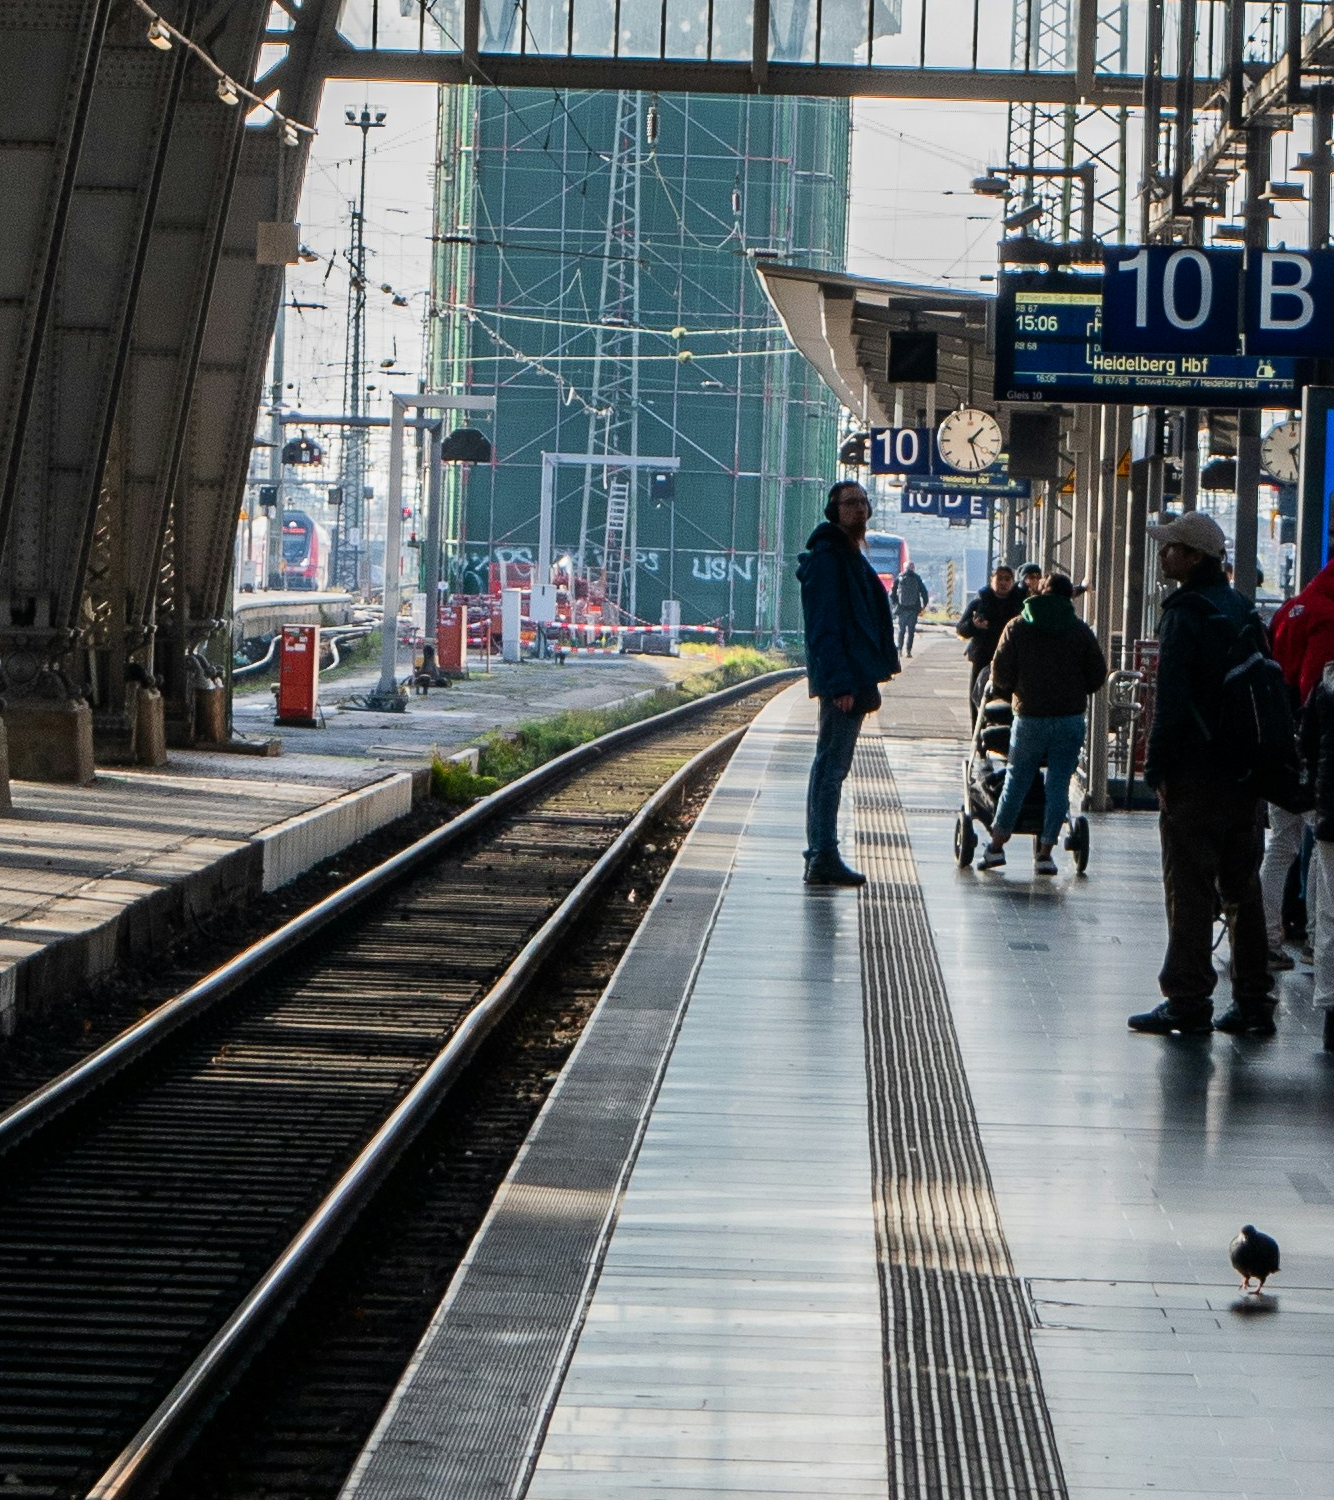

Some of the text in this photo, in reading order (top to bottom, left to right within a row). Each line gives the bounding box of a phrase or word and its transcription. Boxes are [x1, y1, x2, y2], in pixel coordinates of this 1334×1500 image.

[1118, 249, 1315, 331] 10 B
[1028, 304, 1038, 313] 67
[1016, 315, 1058, 332] 15:06
[1093, 354, 1209, 376] Heidelberg Hbf
[1135, 377, 1192, 388] Schwetzingen
[1200, 378, 1243, 389] Heidelberg
[1244, 379, 1259, 389] Hbf
[1006, 390, 1043, 400] Gleis 10
[876, 428, 919, 466] 10
[970, 495, 983, 515] E
[692, 555, 755, 581] USN
